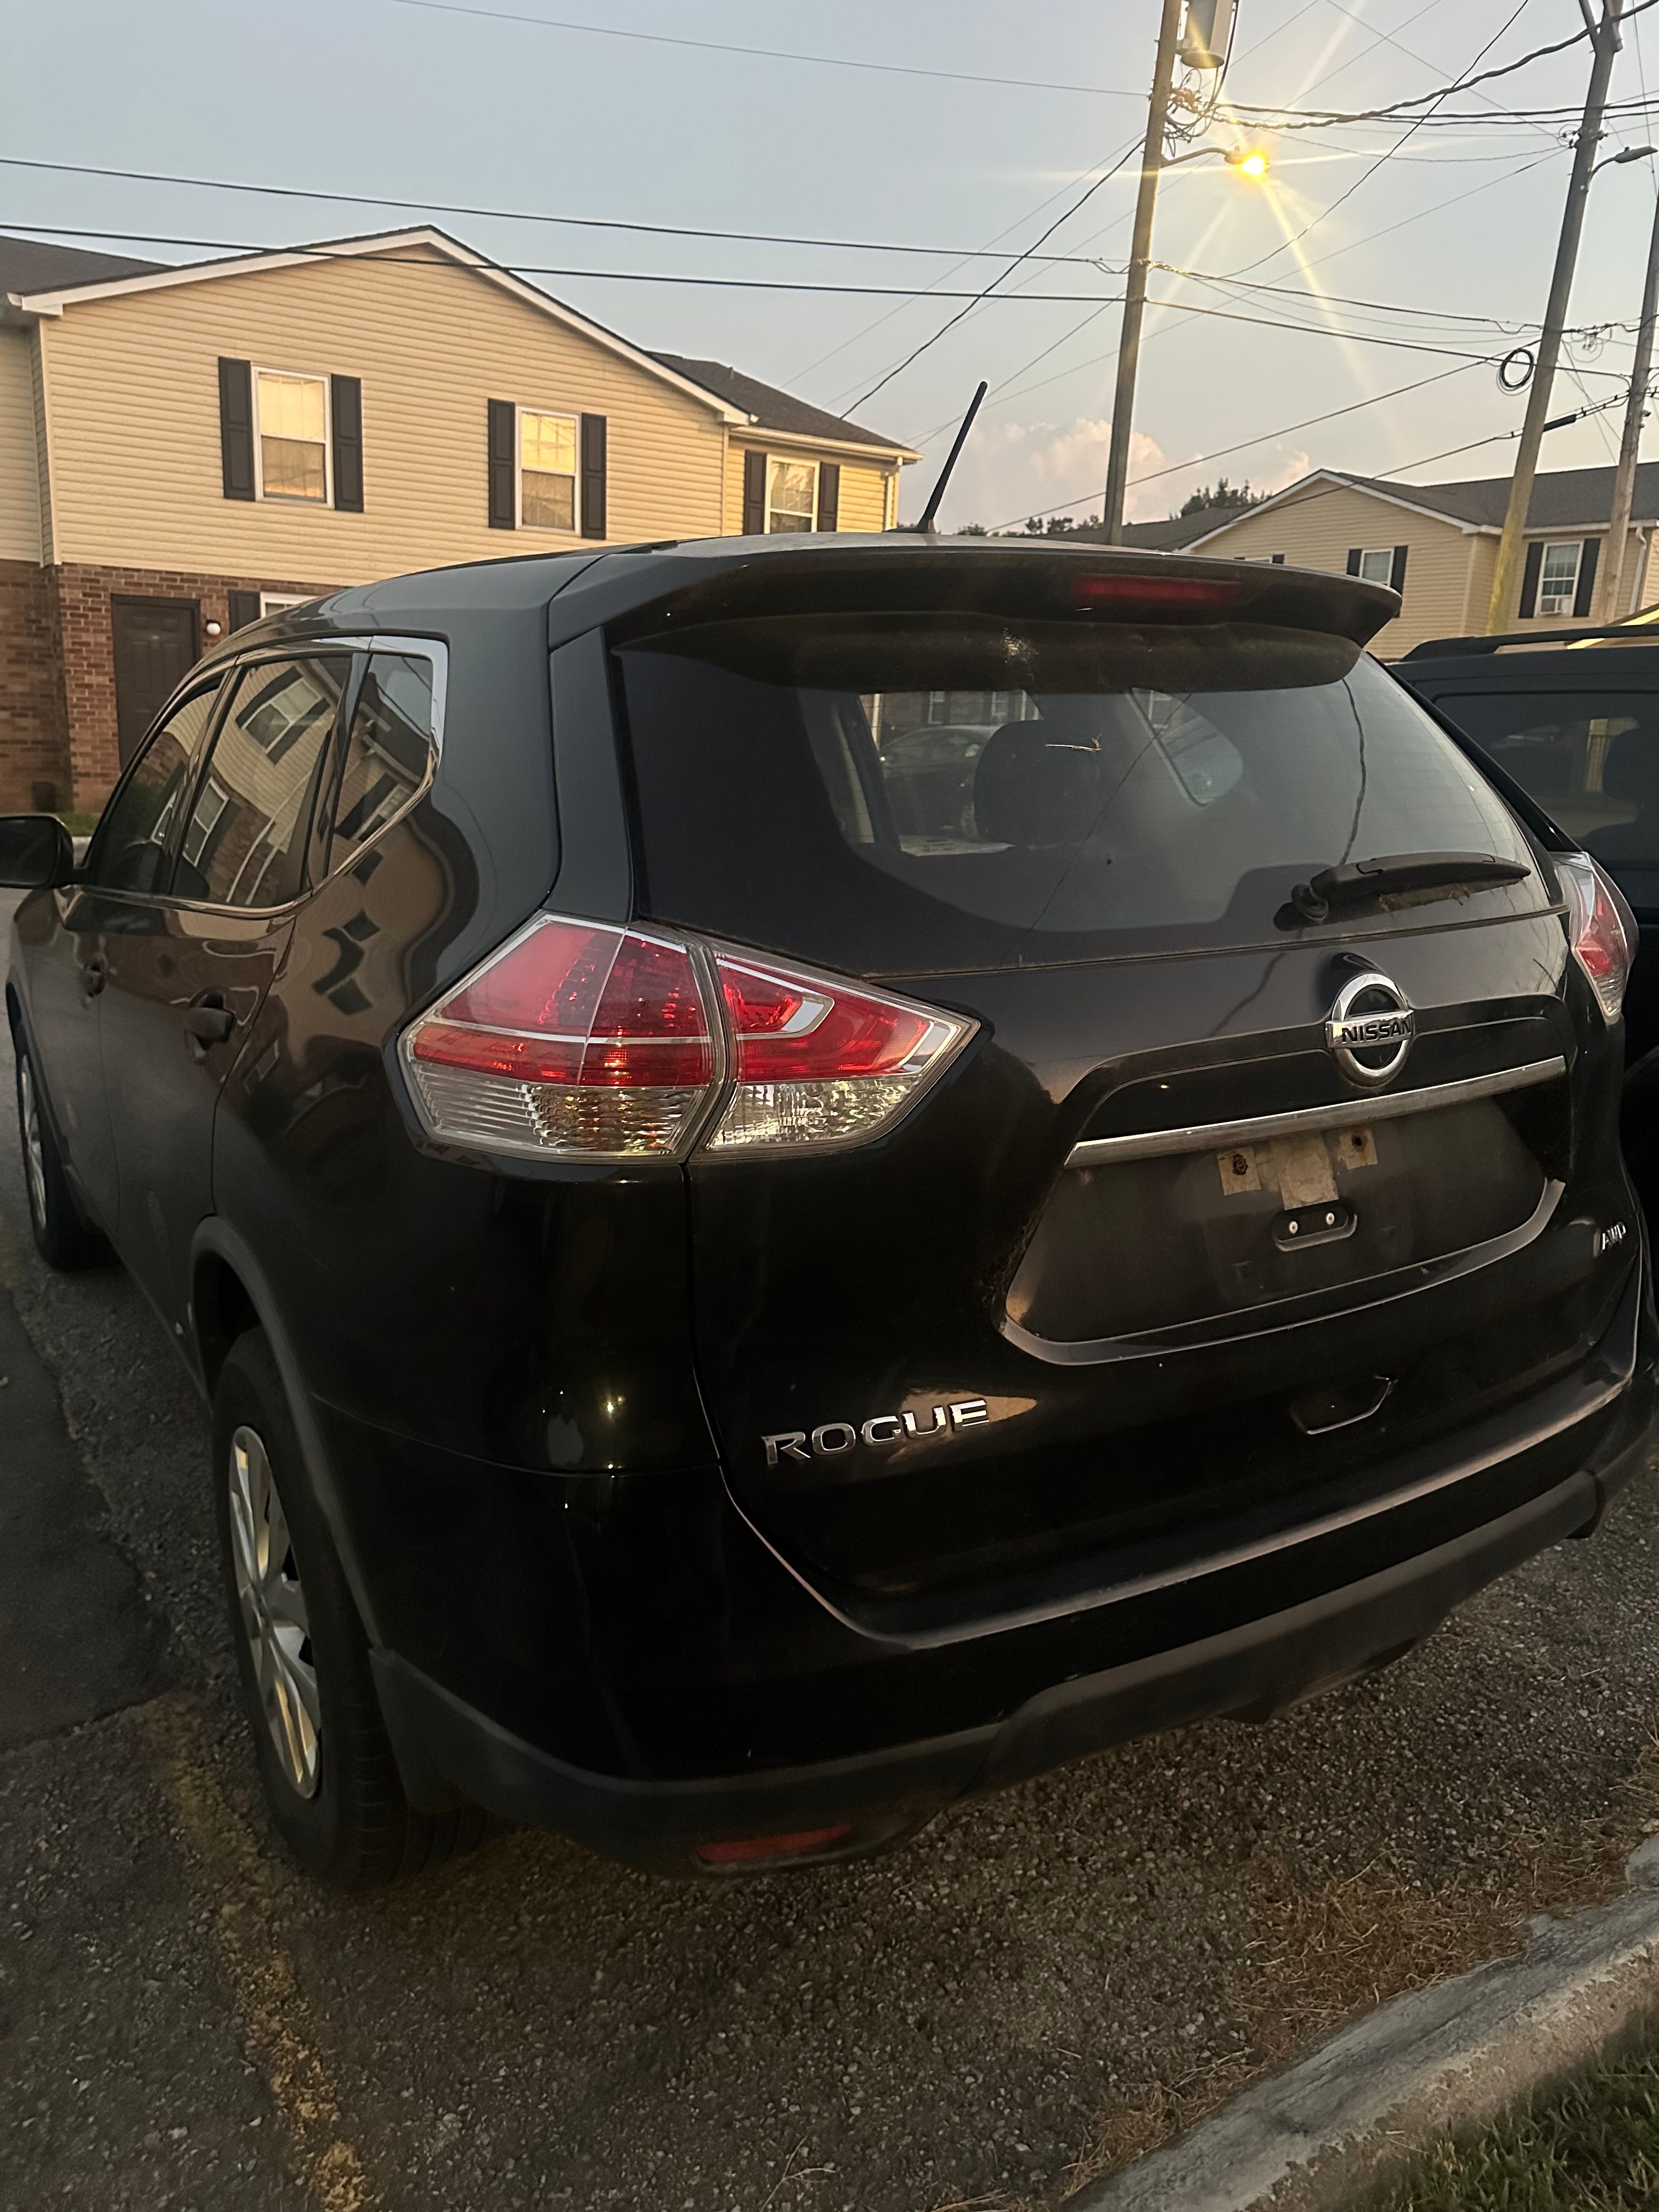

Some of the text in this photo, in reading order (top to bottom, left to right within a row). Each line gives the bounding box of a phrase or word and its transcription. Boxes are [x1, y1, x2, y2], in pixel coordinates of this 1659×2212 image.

[1342, 1018, 1411, 1042] NISSAN
[1602, 1222, 1626, 1250] AWD
[761, 1398, 990, 1465] ROGUE
